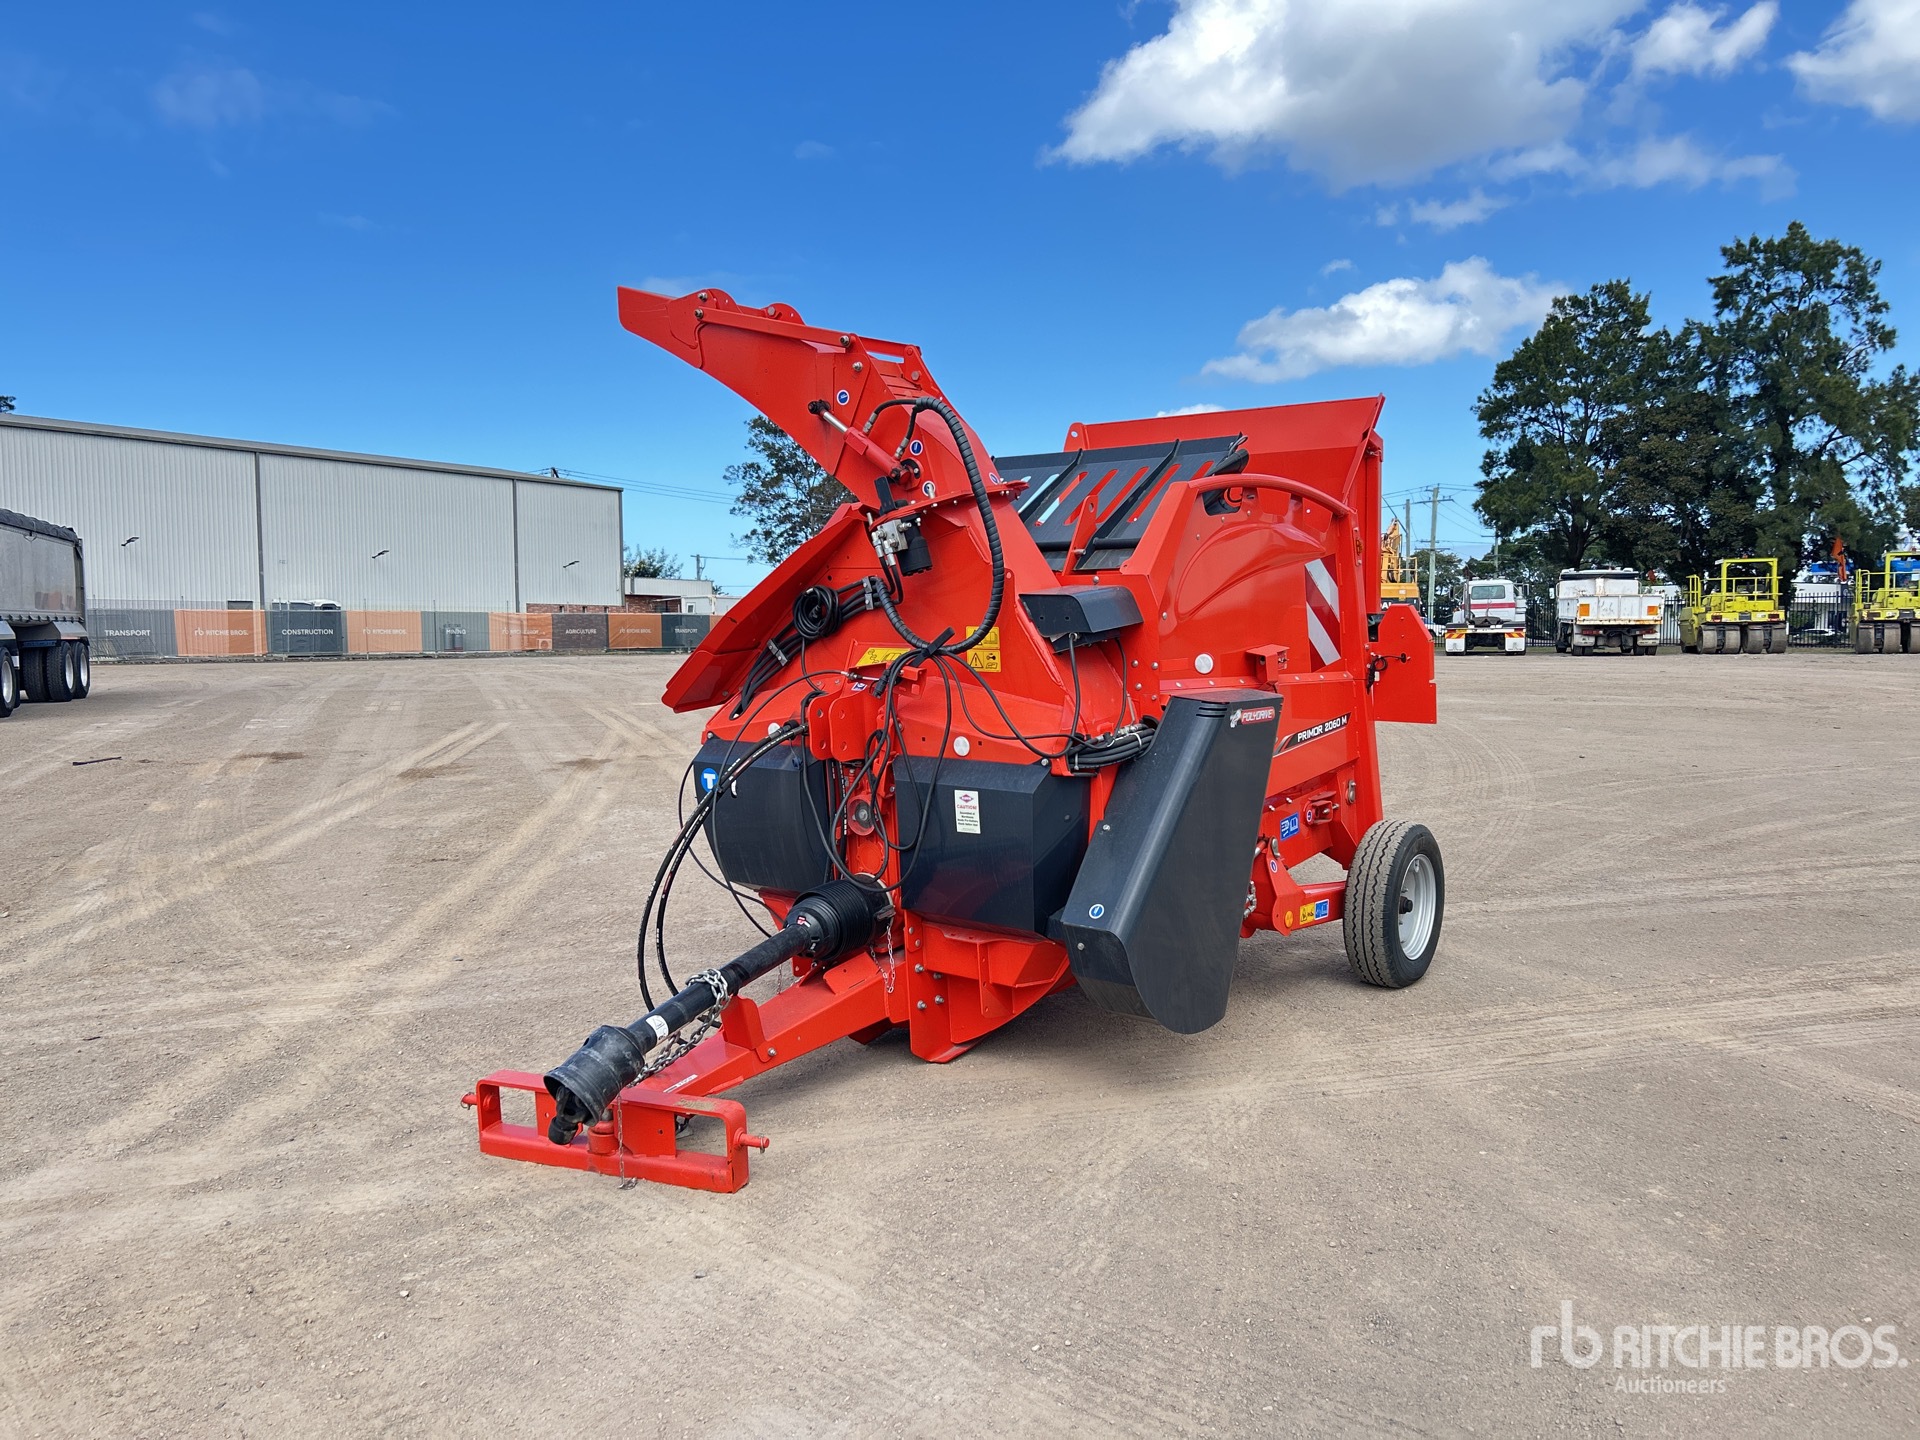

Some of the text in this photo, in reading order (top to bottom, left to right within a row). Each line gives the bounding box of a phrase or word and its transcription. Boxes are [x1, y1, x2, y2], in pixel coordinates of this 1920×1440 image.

[104, 629, 151, 637] TRANSPORT
[1297, 715, 1348, 742] PRIMOR 2060 M
